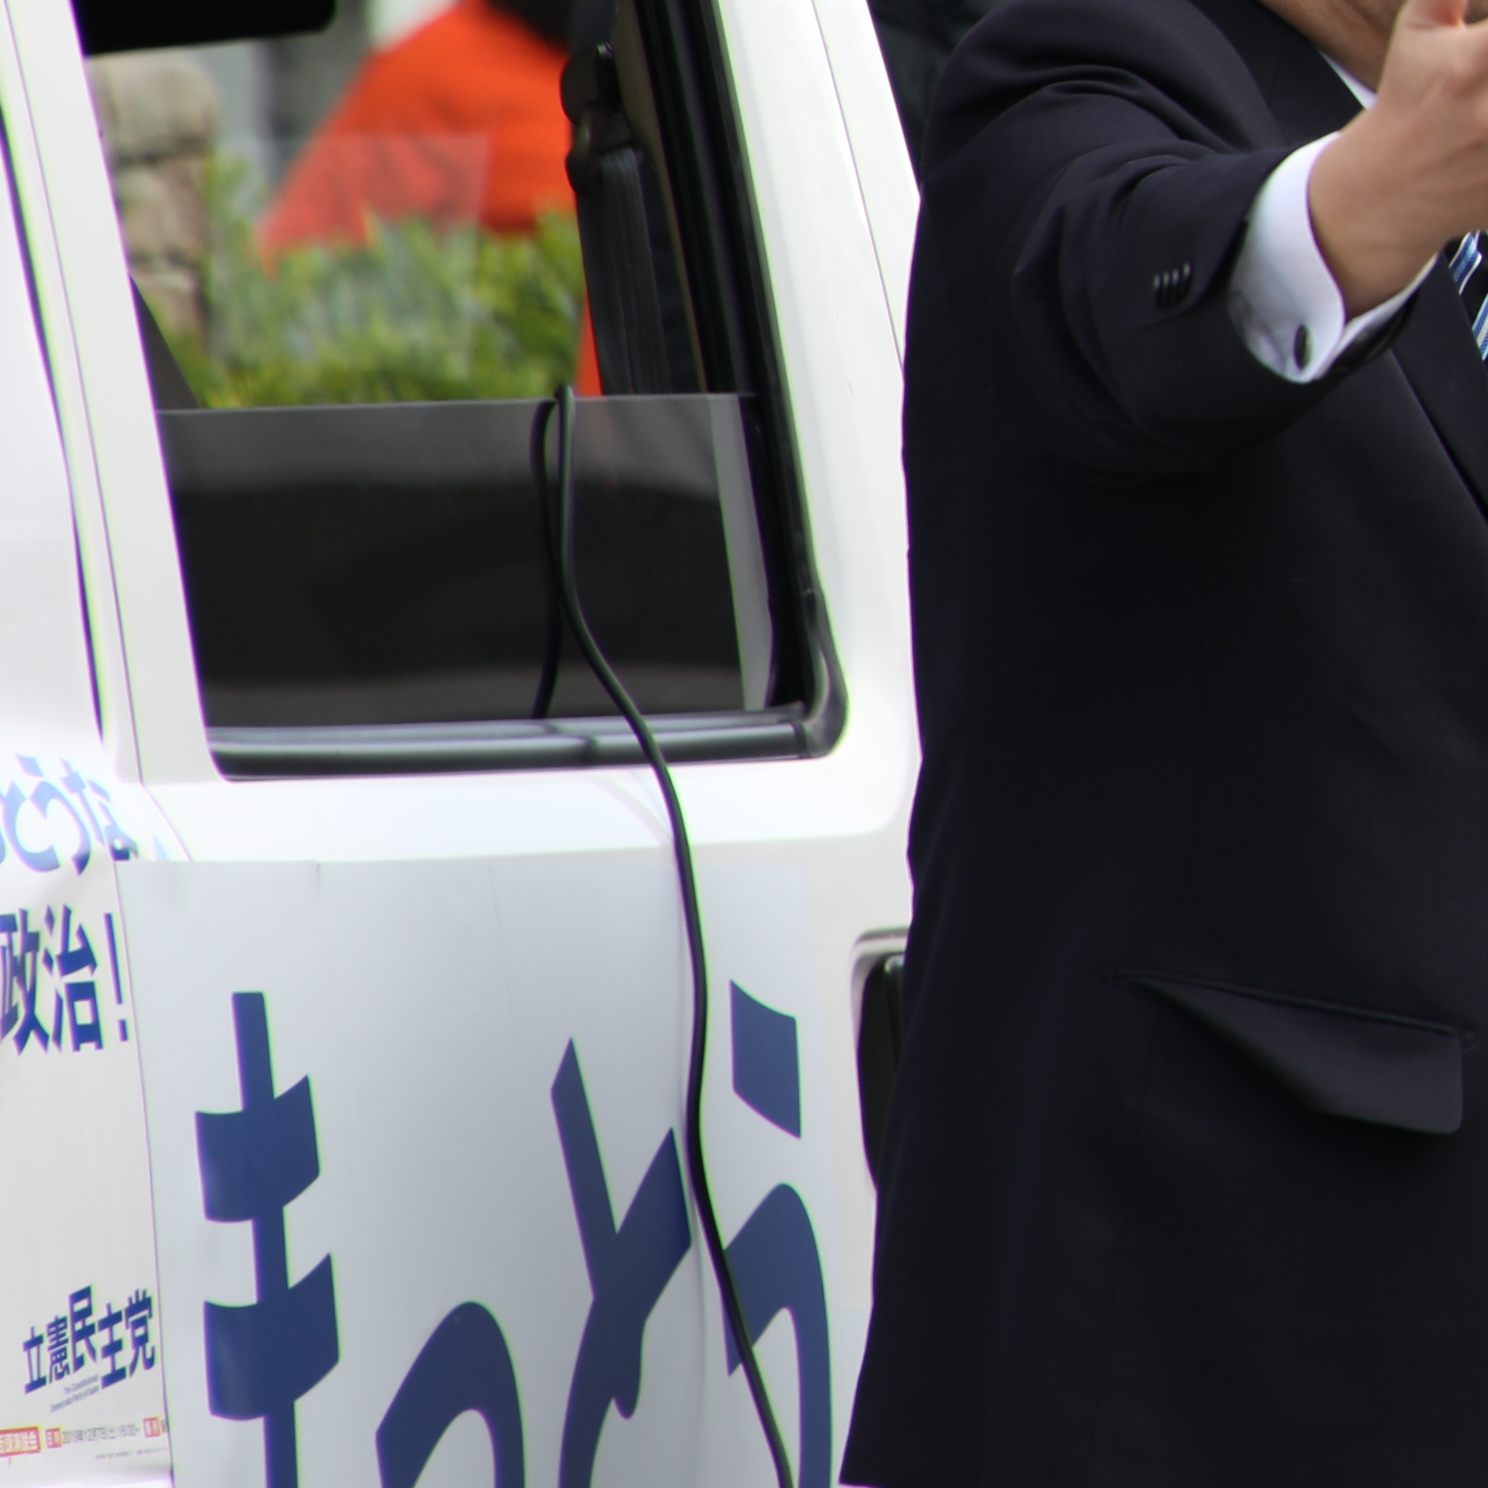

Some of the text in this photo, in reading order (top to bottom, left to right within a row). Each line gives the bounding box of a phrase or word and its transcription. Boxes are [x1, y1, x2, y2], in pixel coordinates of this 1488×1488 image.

[23, 1285, 156, 1395] 立憲民主党
